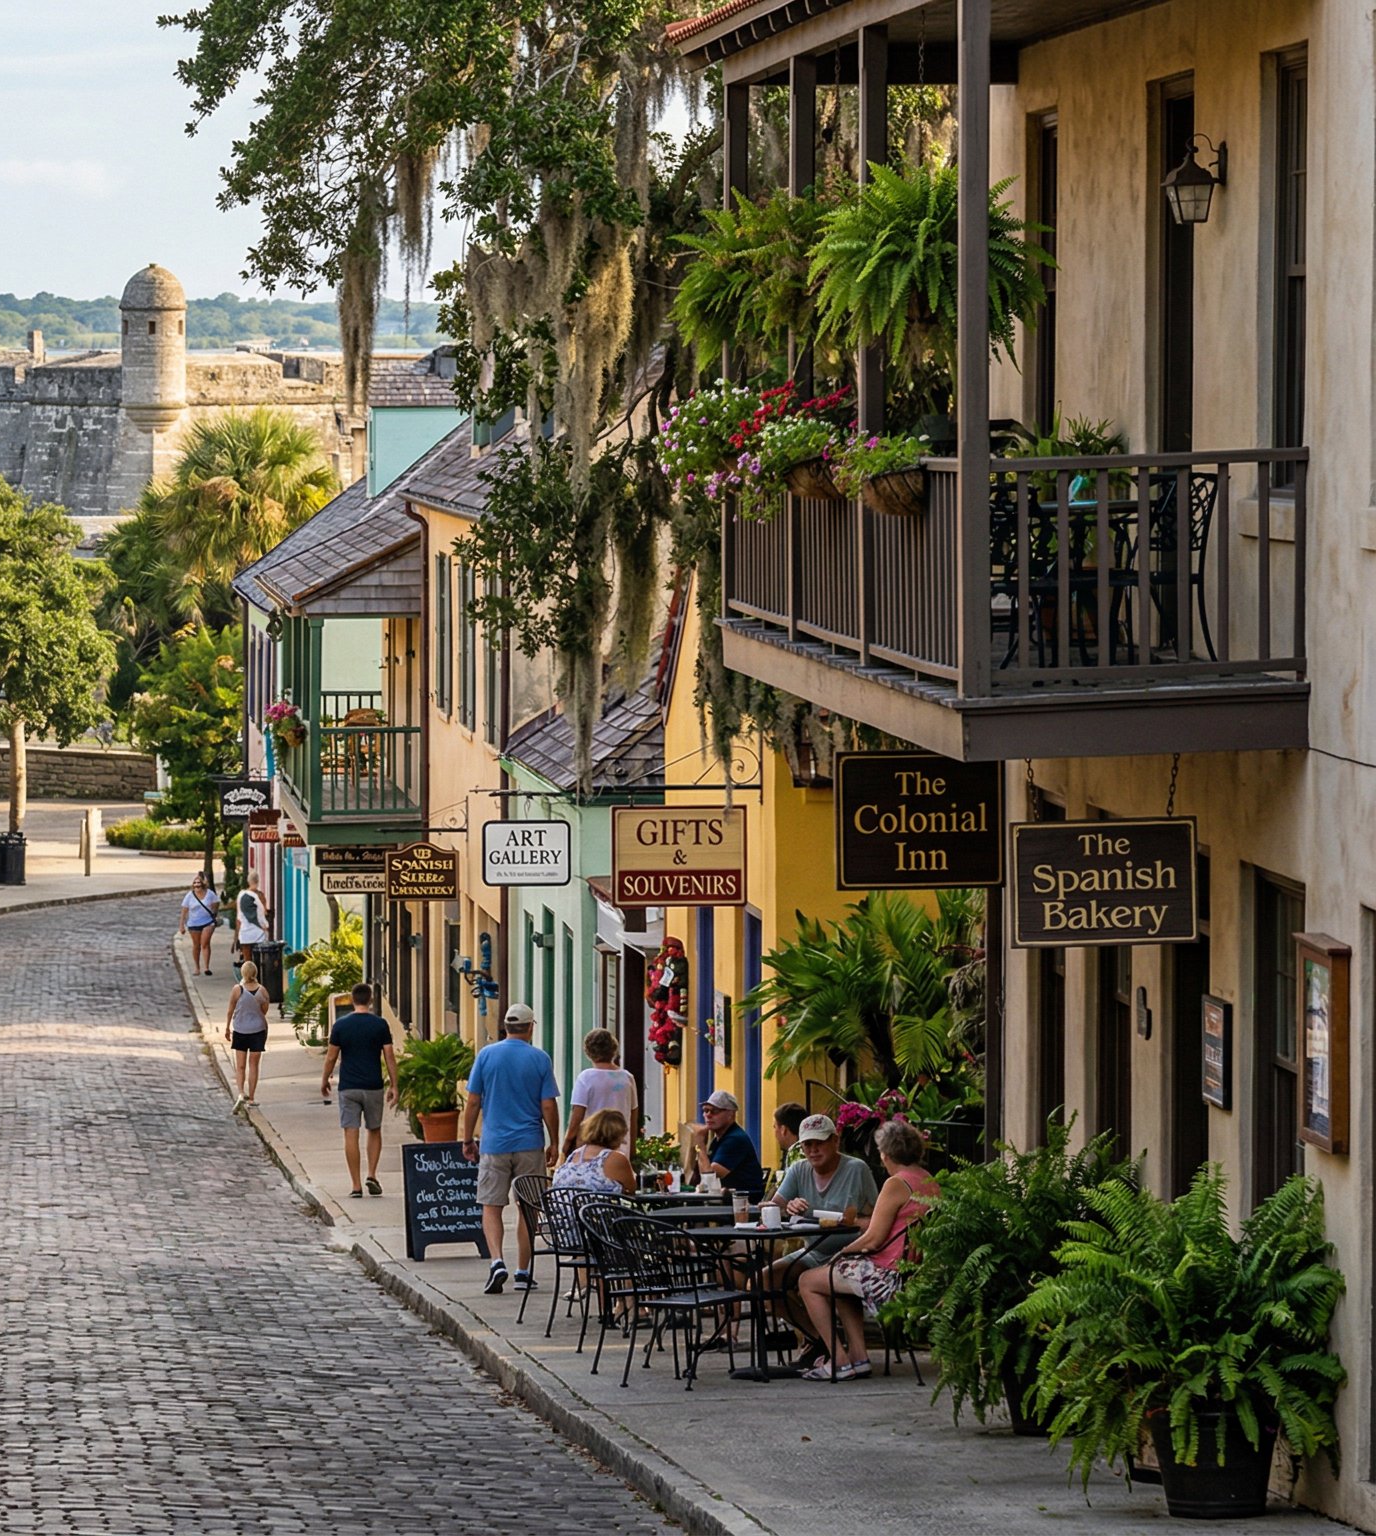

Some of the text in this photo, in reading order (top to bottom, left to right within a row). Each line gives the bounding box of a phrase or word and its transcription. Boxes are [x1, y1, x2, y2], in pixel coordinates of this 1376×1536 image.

[894, 771, 947, 796] The
[853, 802, 988, 834] Colonial
[505, 829, 547, 847] ART
[636, 818, 723, 846] GIFTS
[1077, 833, 1131, 856] The
[489, 849, 562, 865] GALLERY
[672, 848, 688, 865] &
[894, 841, 949, 872] Inn
[623, 874, 737, 896] SOUVENIRS
[1032, 859, 1177, 901] Spanish
[1042, 900, 1169, 935] Bakery
